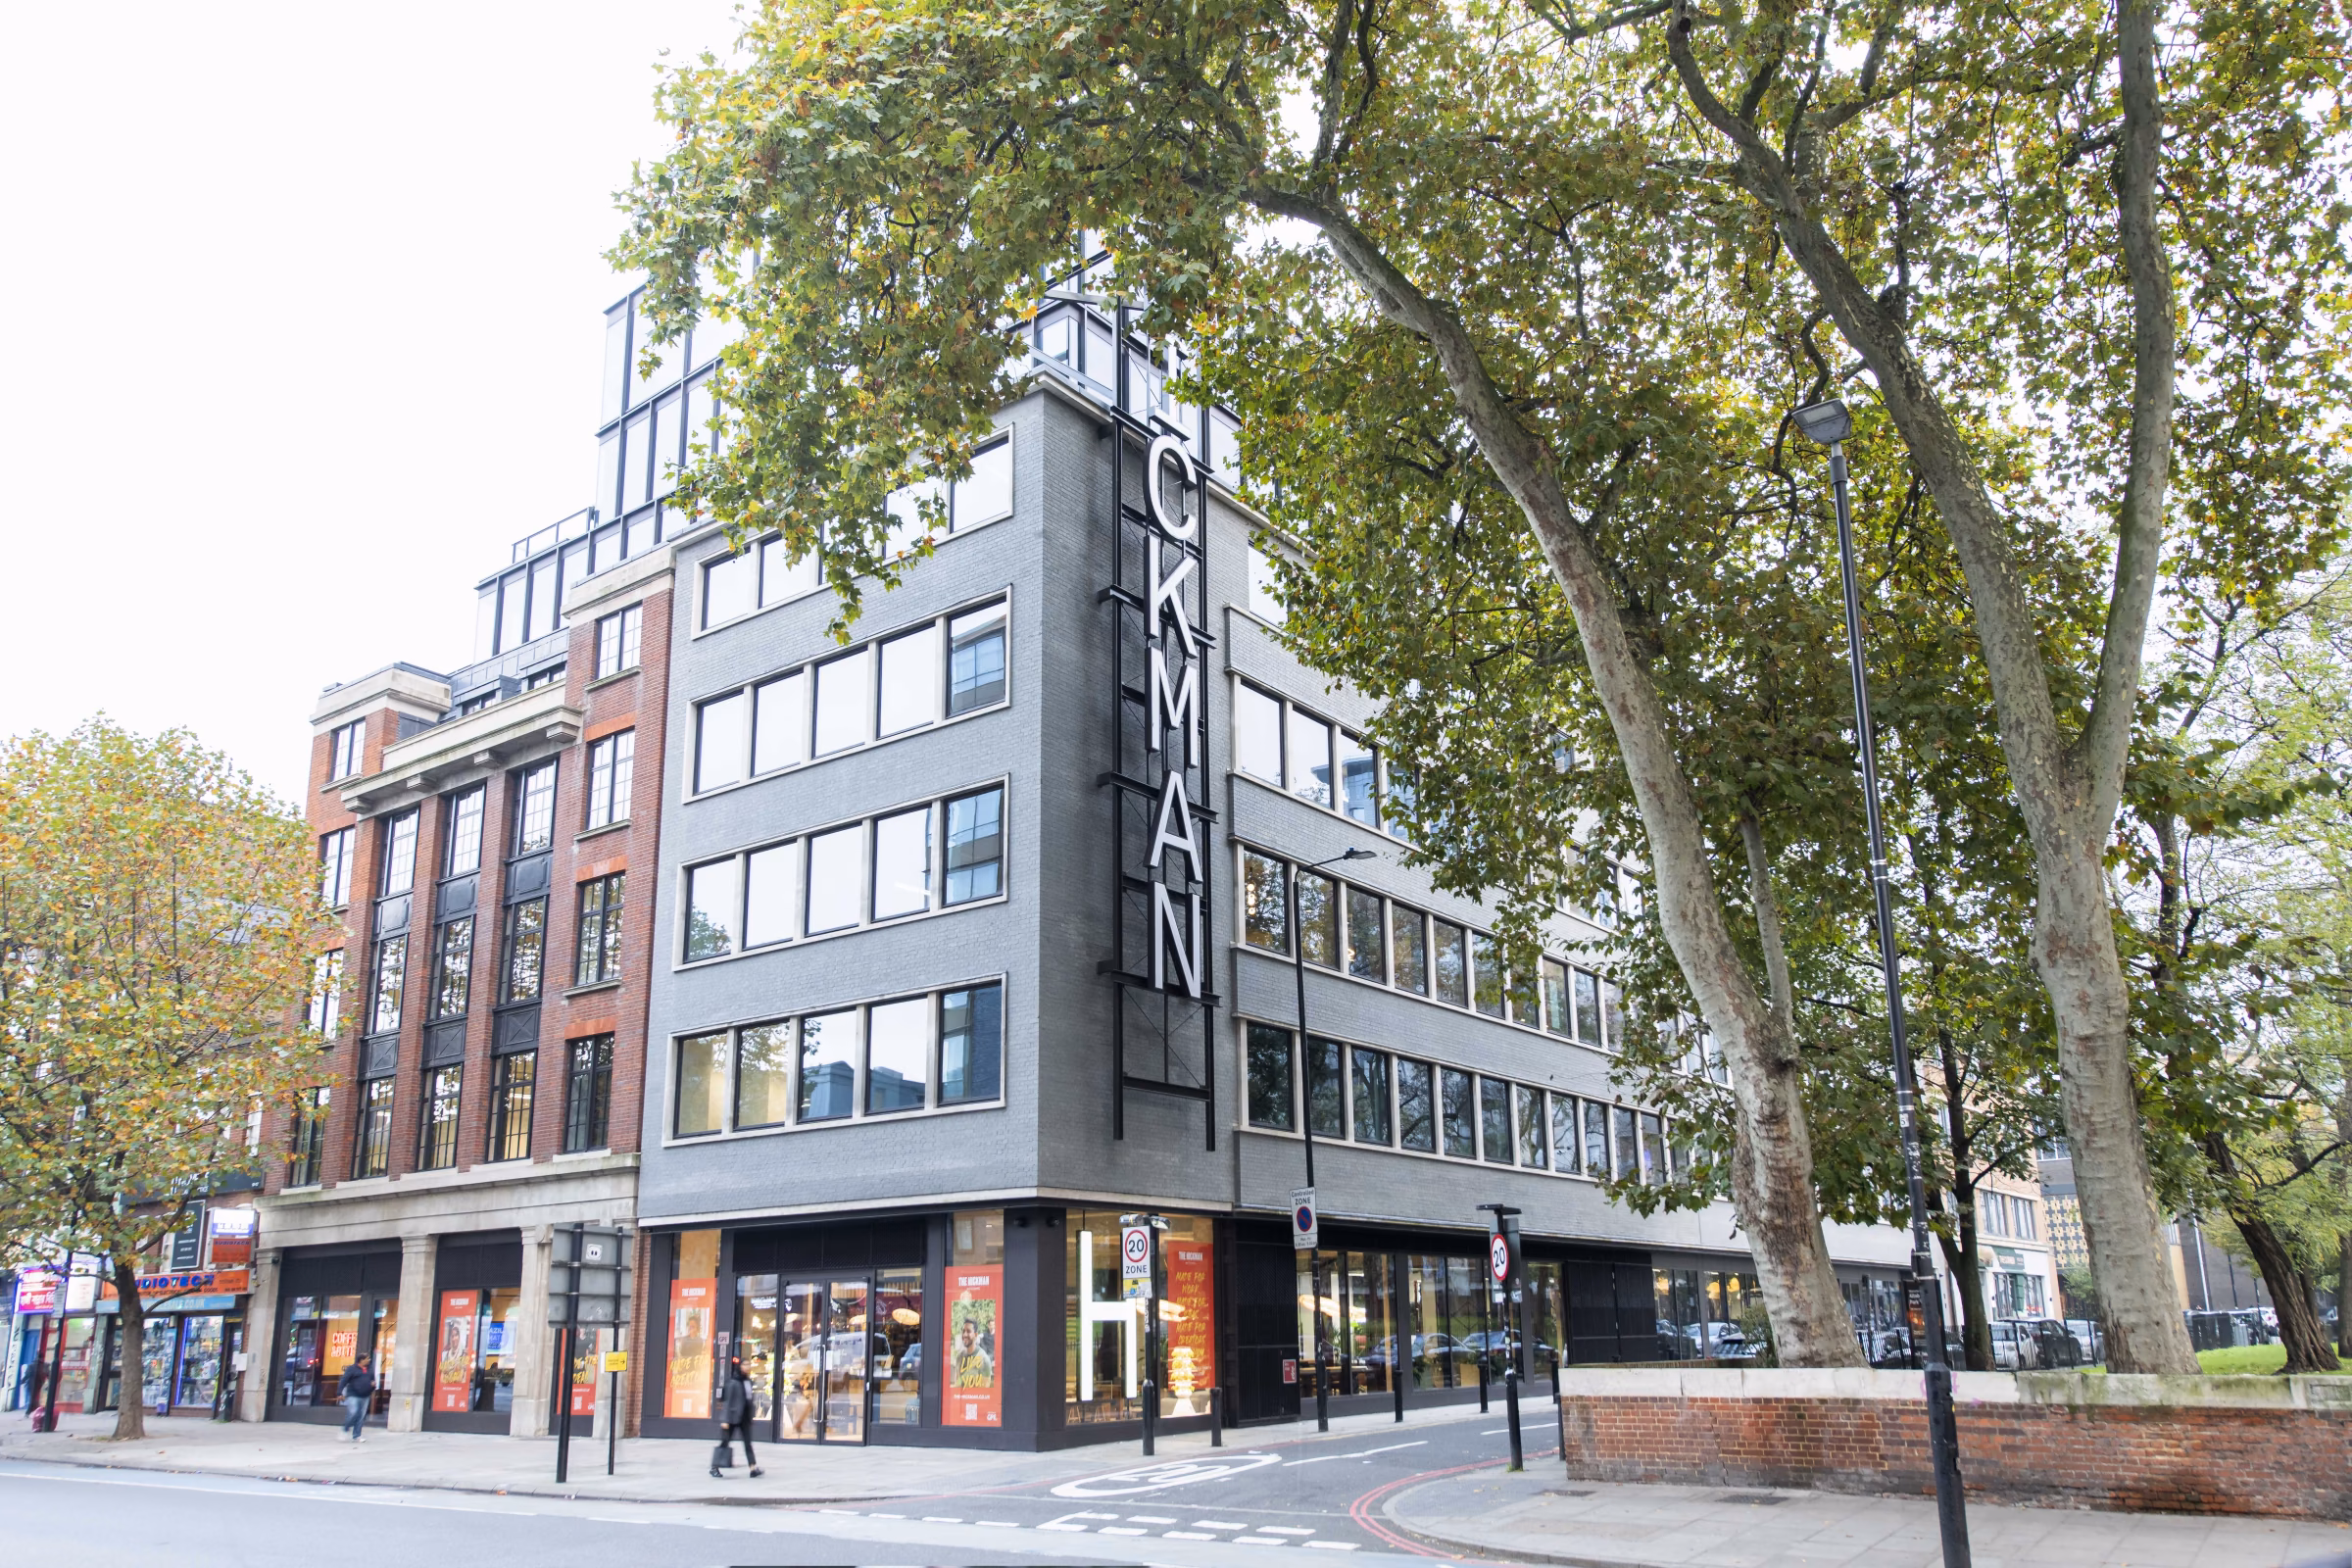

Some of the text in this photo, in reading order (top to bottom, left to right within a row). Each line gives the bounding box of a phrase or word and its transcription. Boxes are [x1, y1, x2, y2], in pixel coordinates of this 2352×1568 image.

[1295, 1197, 1311, 1205] ZONE
[1128, 1239, 1145, 1253] 20
[1493, 1246, 1506, 1269] 20
[1125, 1264, 1148, 1274] ZONE
[957, 1275, 990, 1287] THE HICKMAN
[960, 1355, 984, 1373] LIKE
